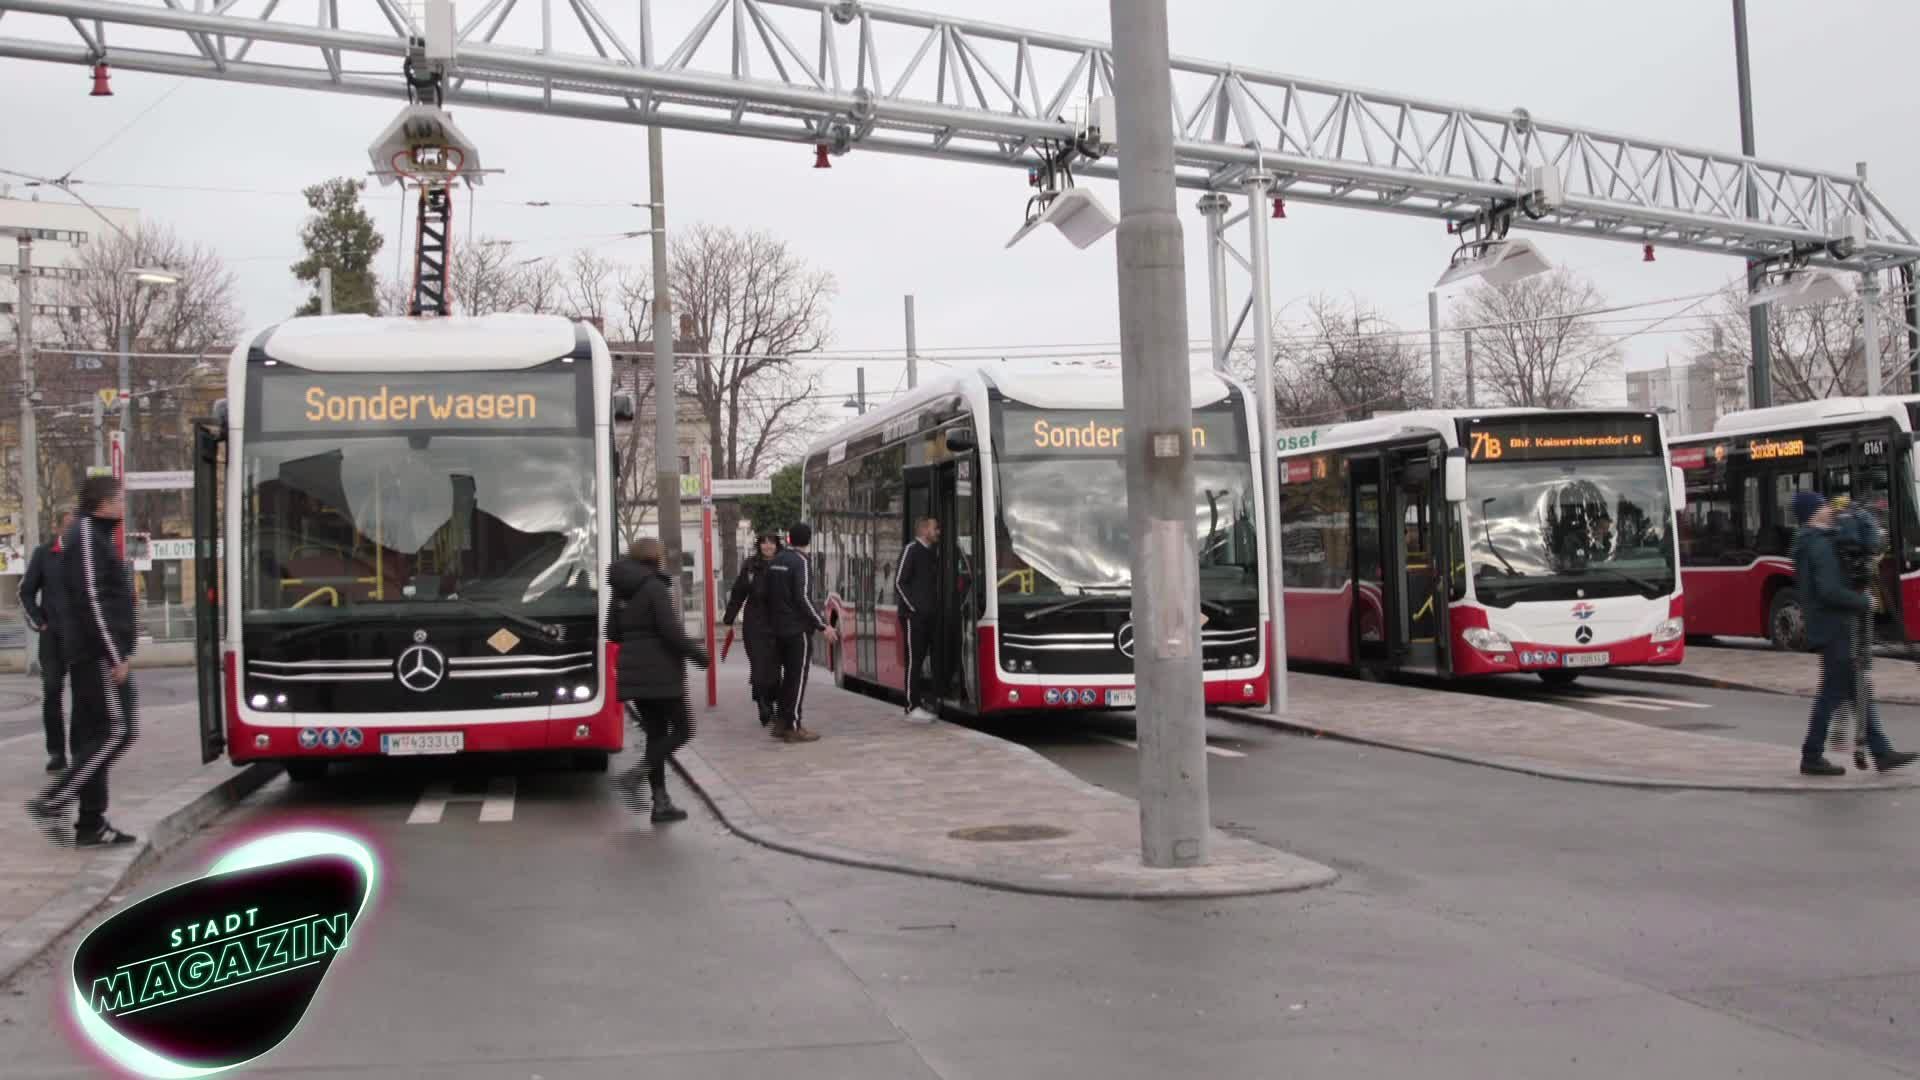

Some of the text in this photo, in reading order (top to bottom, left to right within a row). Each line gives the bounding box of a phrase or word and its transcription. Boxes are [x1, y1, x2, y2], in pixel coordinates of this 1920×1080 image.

[305, 385, 537, 421] Sonderwagen
[1033, 419, 1206, 448] Sondern
[1470, 432, 1502, 459] 71B
[1750, 438, 1804, 460] Sonderwagen
[1864, 440, 1883, 455] 8161
